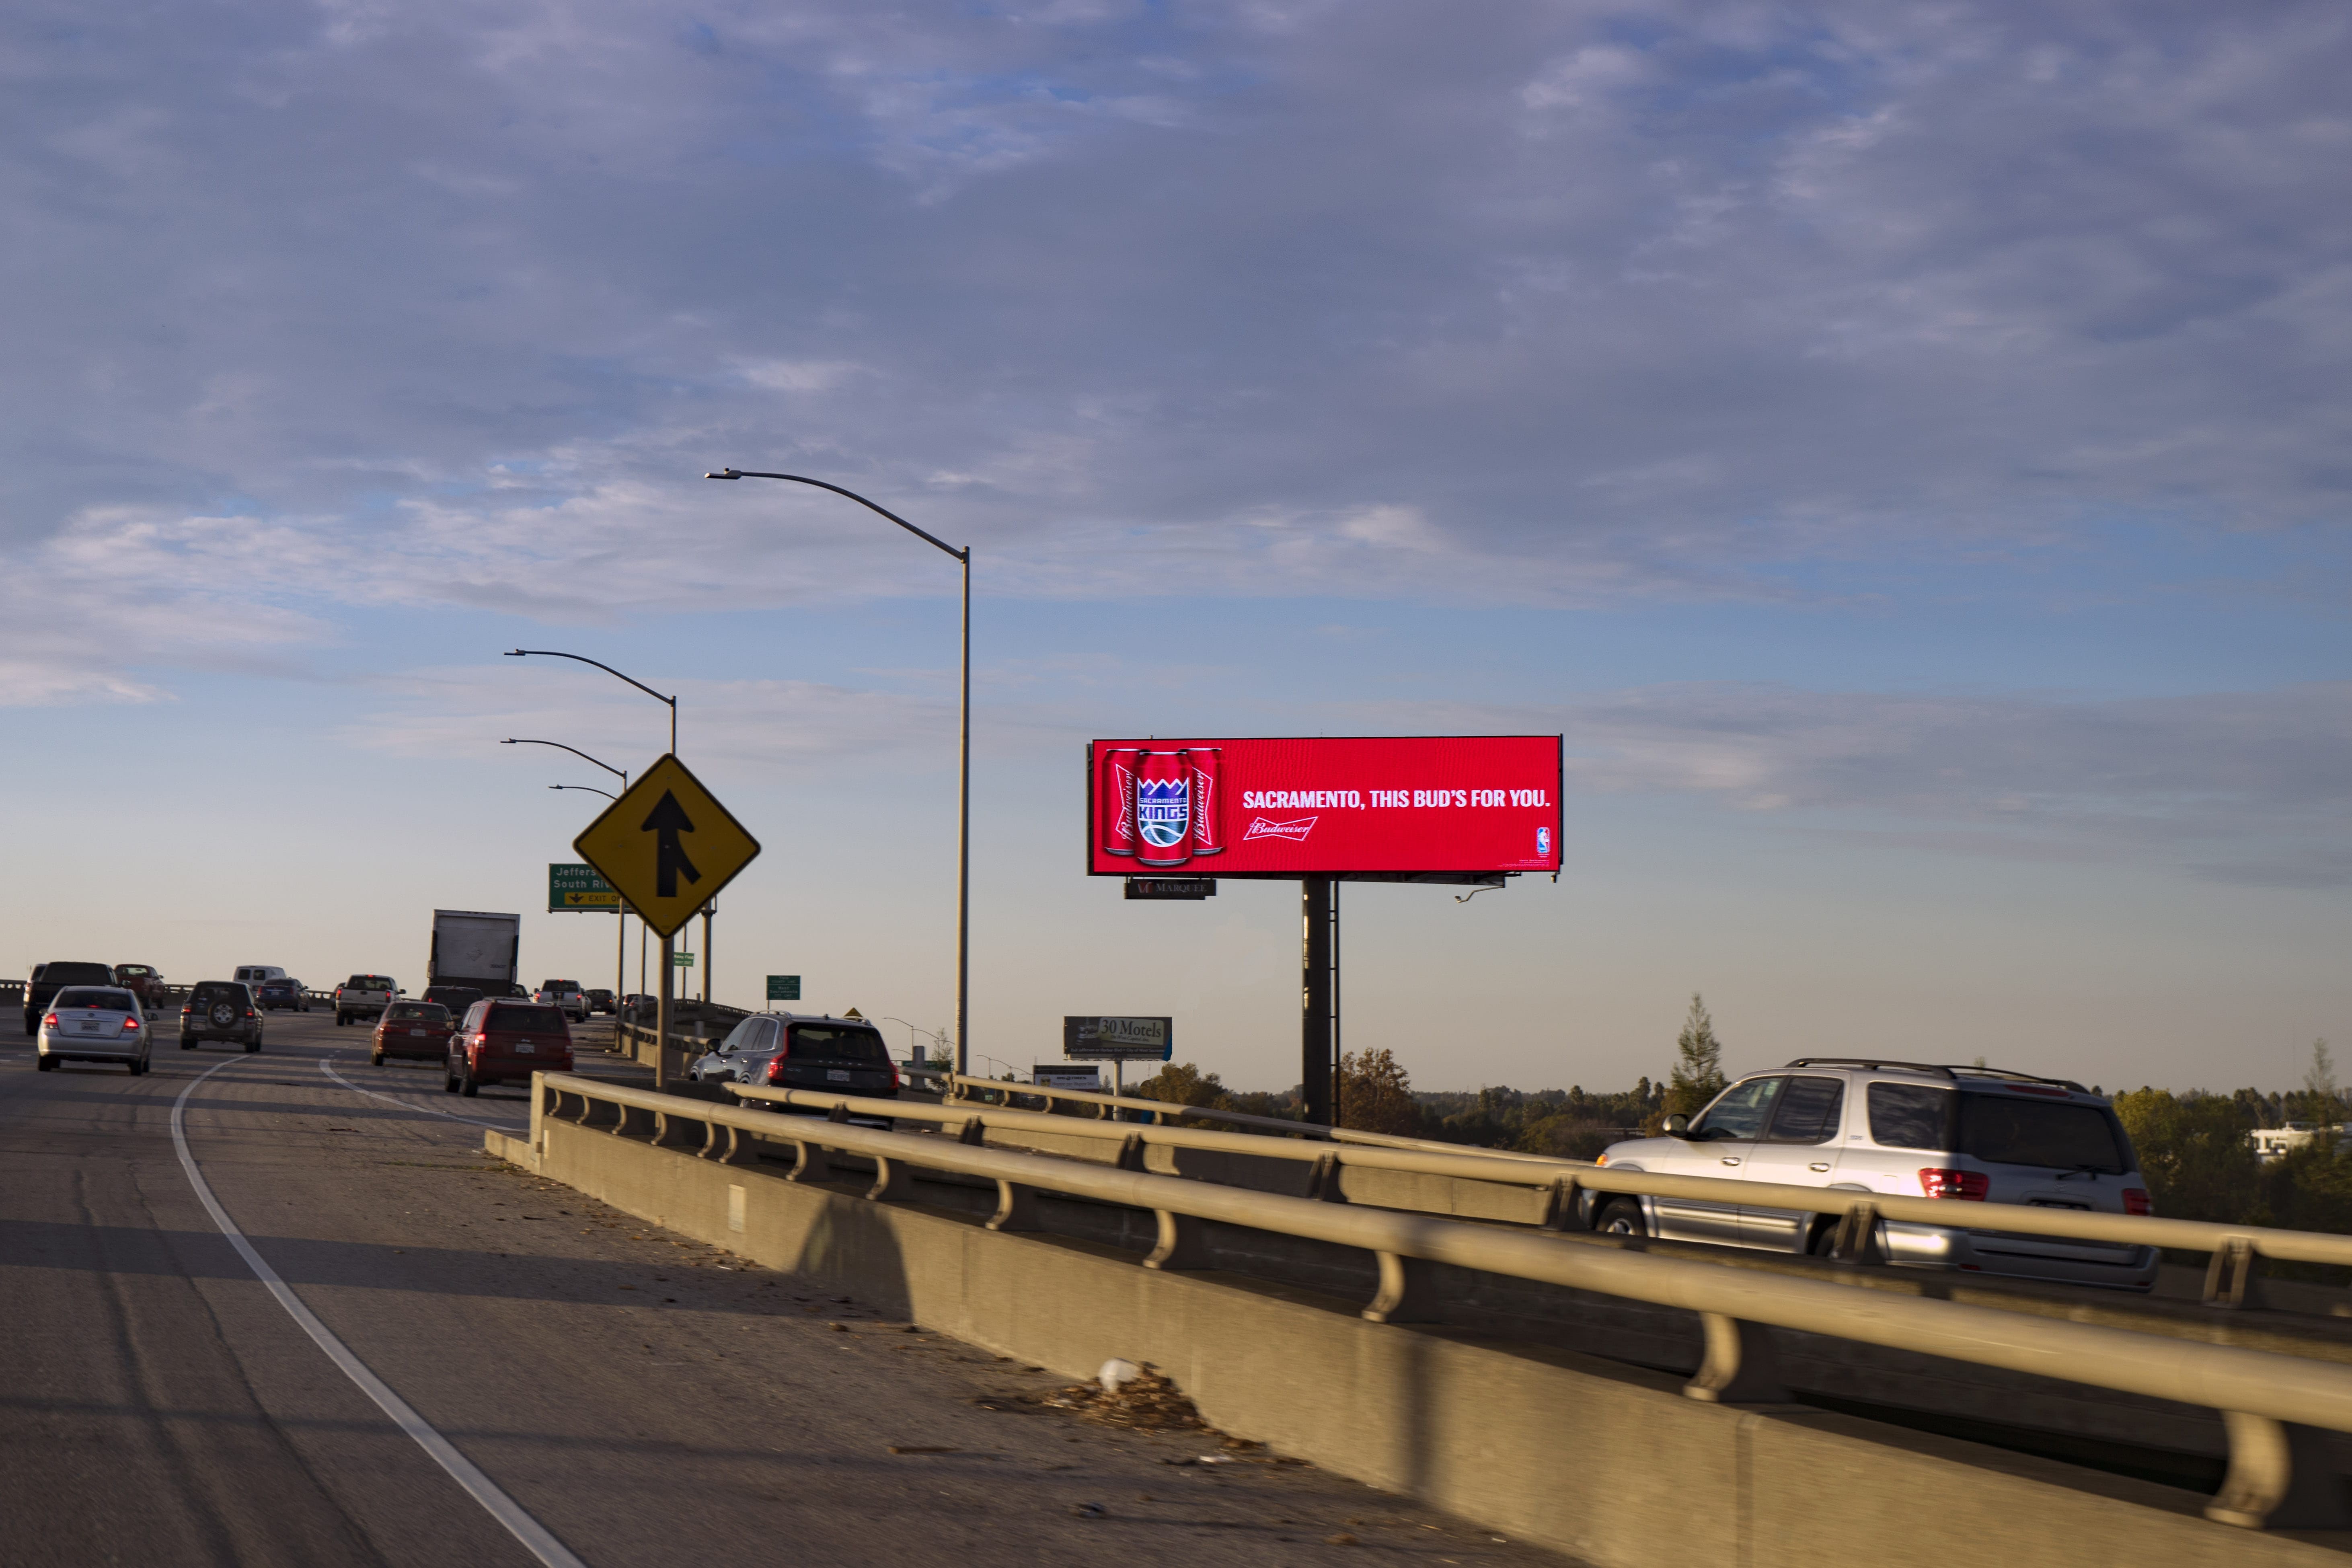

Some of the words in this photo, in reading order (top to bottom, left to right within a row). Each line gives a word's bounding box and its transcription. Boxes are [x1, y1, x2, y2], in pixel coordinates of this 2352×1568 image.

[1121, 771, 1135, 842] Budweiser
[1193, 771, 1206, 839] Budweiser
[1243, 790, 1366, 810] SACRAMENTO,
[1369, 790, 1409, 808] THIS
[1471, 789, 1506, 807] FOR
[1509, 789, 1551, 808] YOU.
[1139, 807, 1187, 819] KINGS
[1251, 820, 1310, 834] Budweiser
[556, 867, 596, 876] Jeffers
[554, 880, 587, 888] South
[592, 880, 610, 888] Riv
[1156, 883, 1206, 892] MARQUEE
[1101, 1020, 1116, 1034] 30
[1120, 1020, 1161, 1037] Motels
